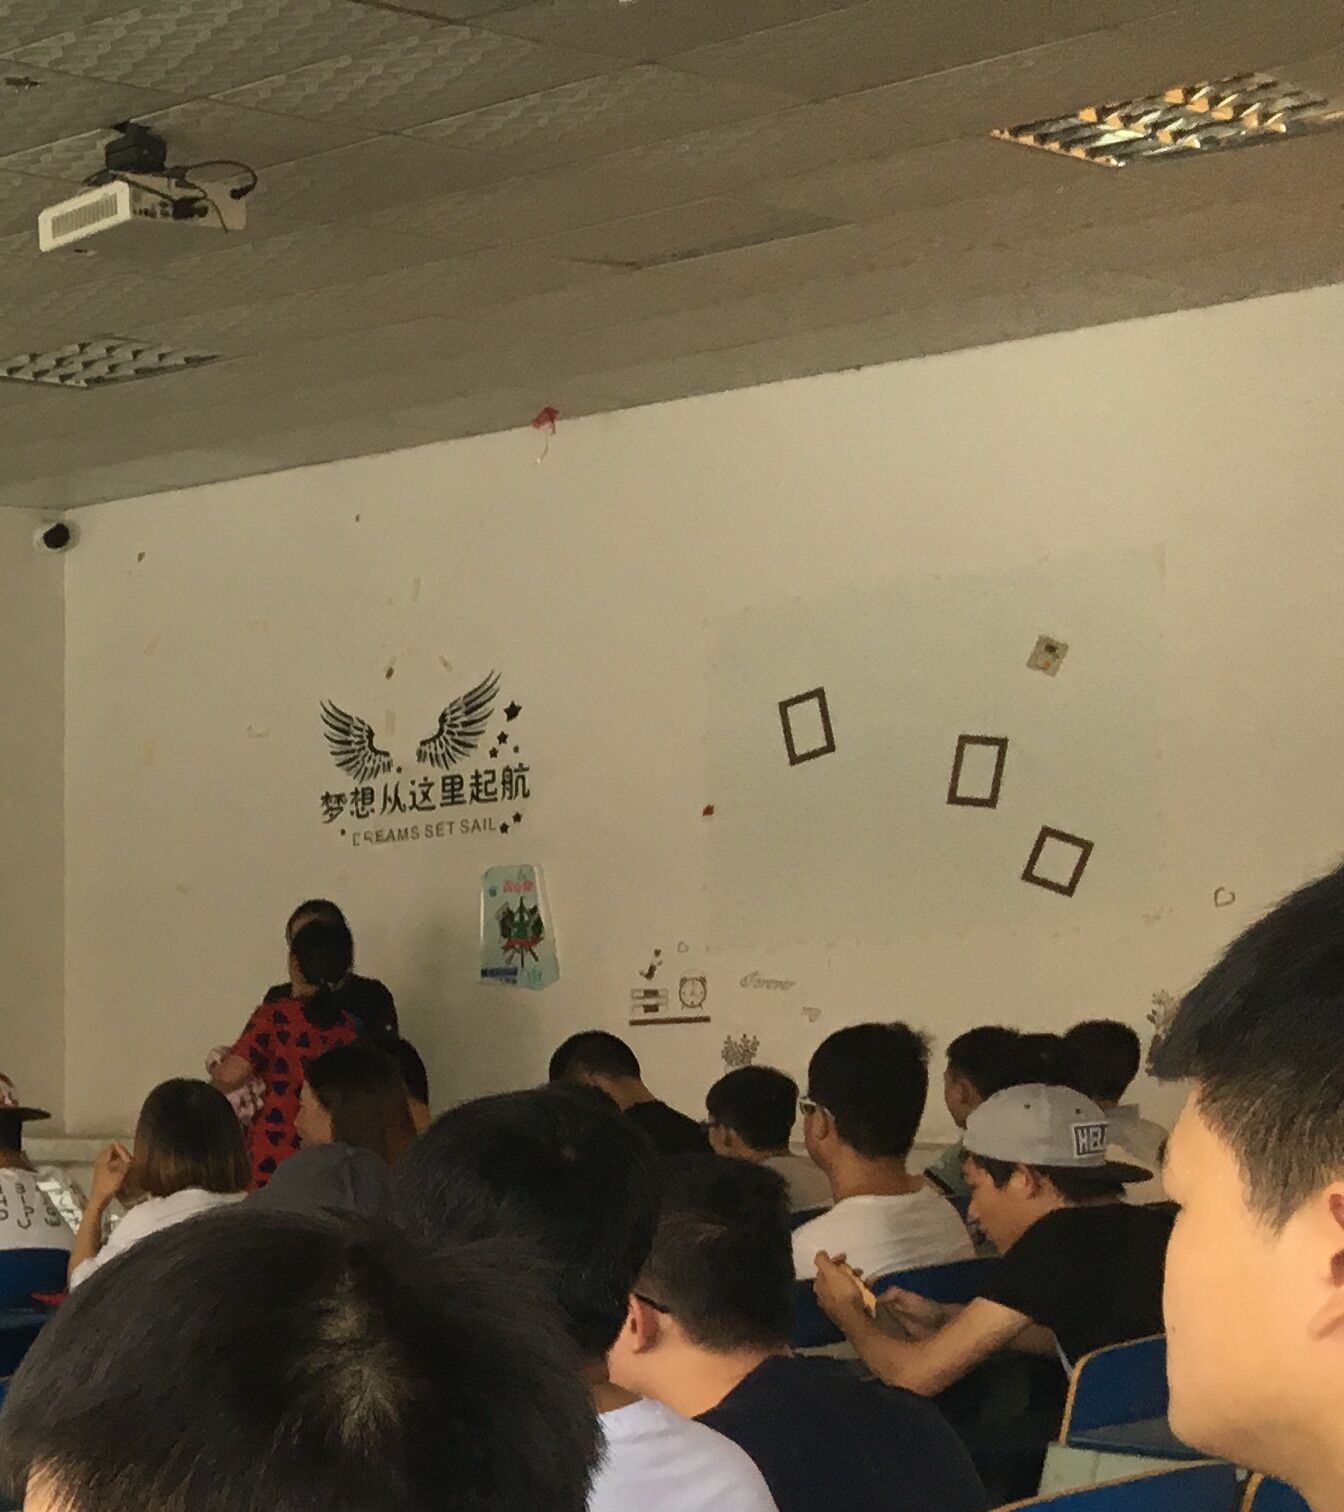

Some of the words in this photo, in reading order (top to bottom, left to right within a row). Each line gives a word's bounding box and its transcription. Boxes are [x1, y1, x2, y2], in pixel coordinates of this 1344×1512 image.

[320, 763, 530, 824] 梦想从这里起航
[424, 821, 455, 839] SET
[459, 817, 496, 835] SAIL
